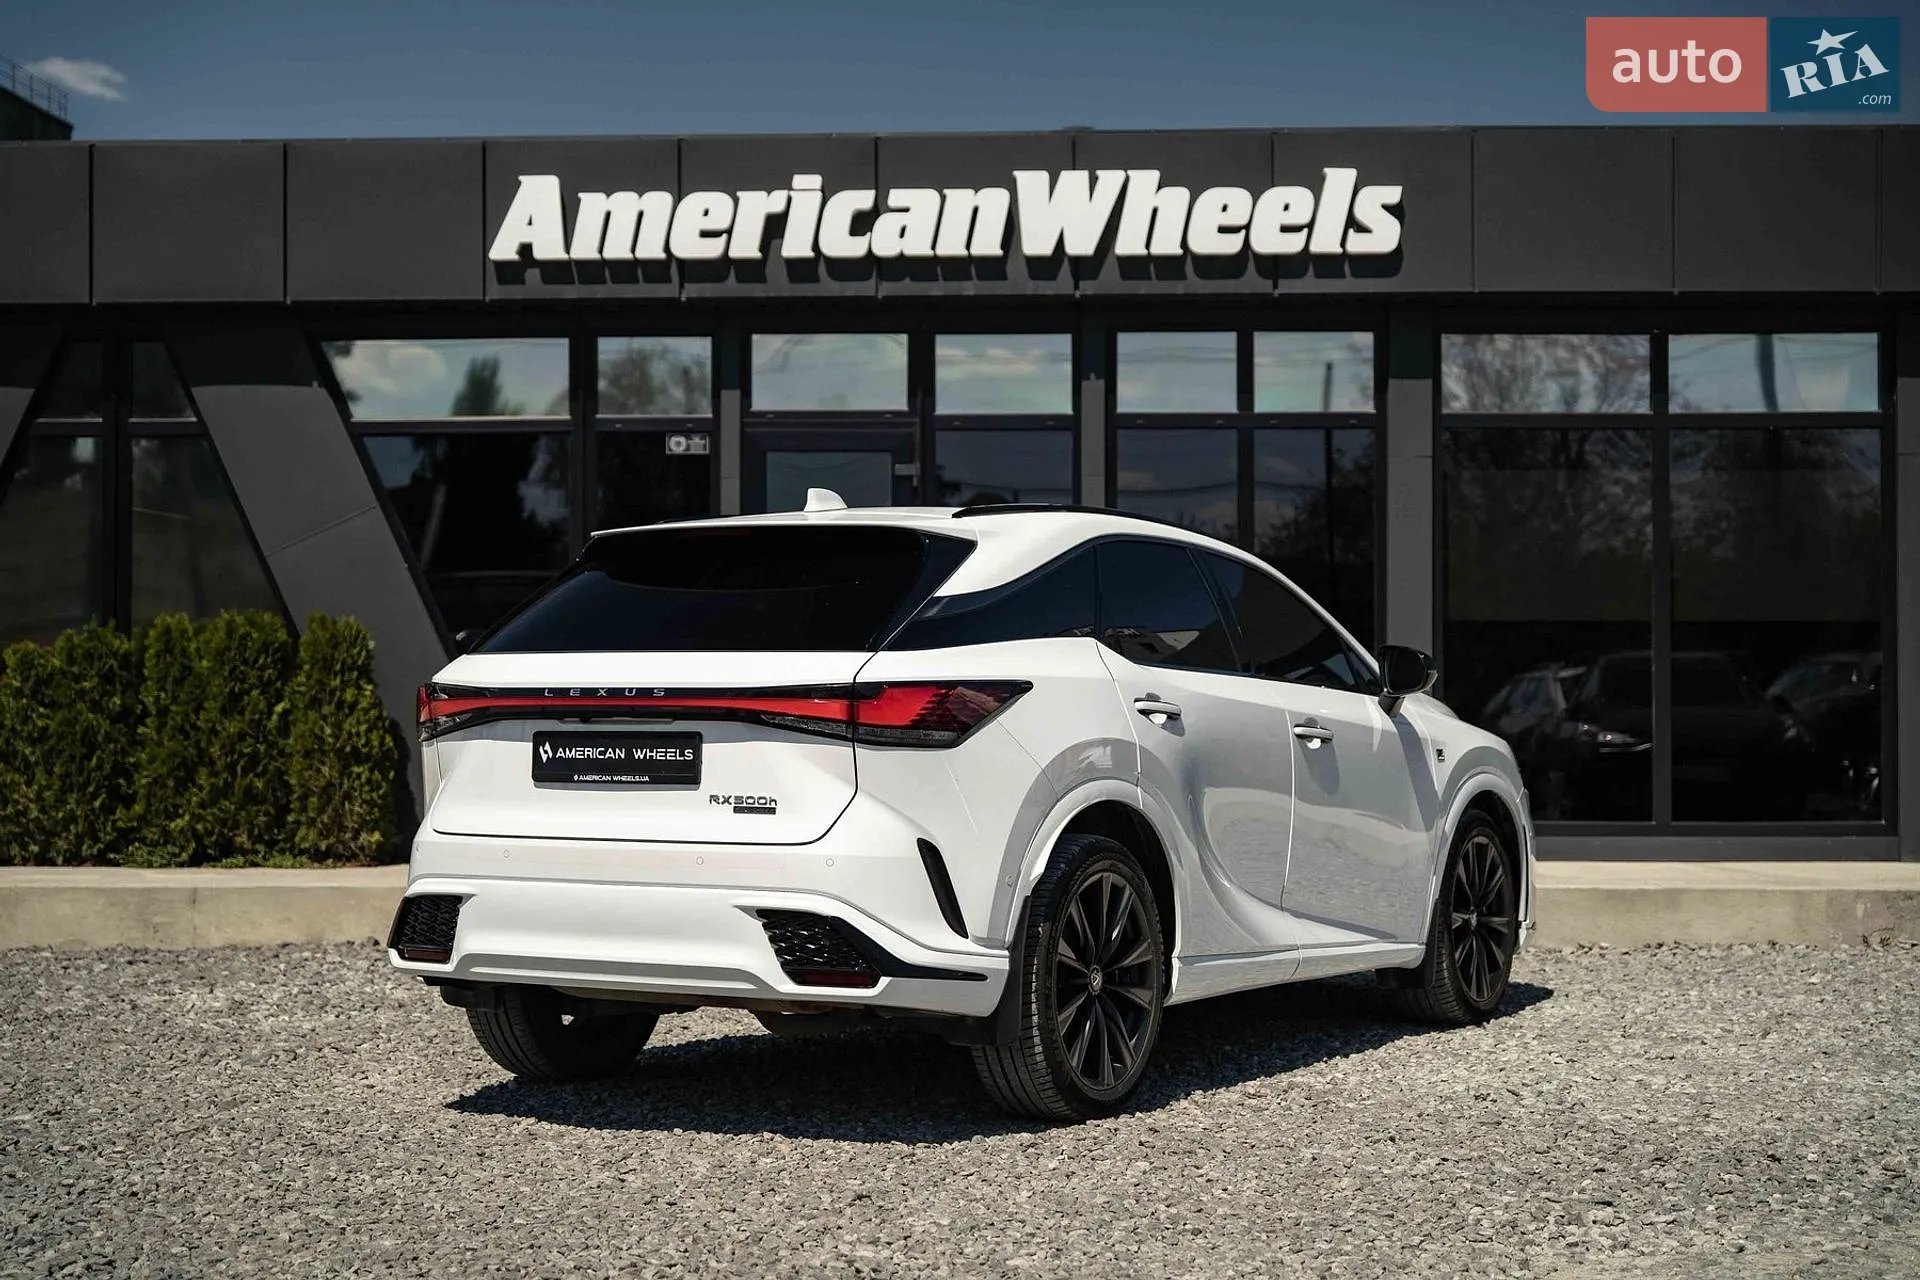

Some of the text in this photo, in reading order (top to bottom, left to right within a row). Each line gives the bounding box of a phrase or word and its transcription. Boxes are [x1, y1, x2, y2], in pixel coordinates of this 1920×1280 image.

[488, 167, 1403, 262] AmericanWheels
[544, 688, 665, 697] LEXUS
[556, 748, 694, 760] AMERICAN WHEELS
[709, 795, 777, 806] RX500h
